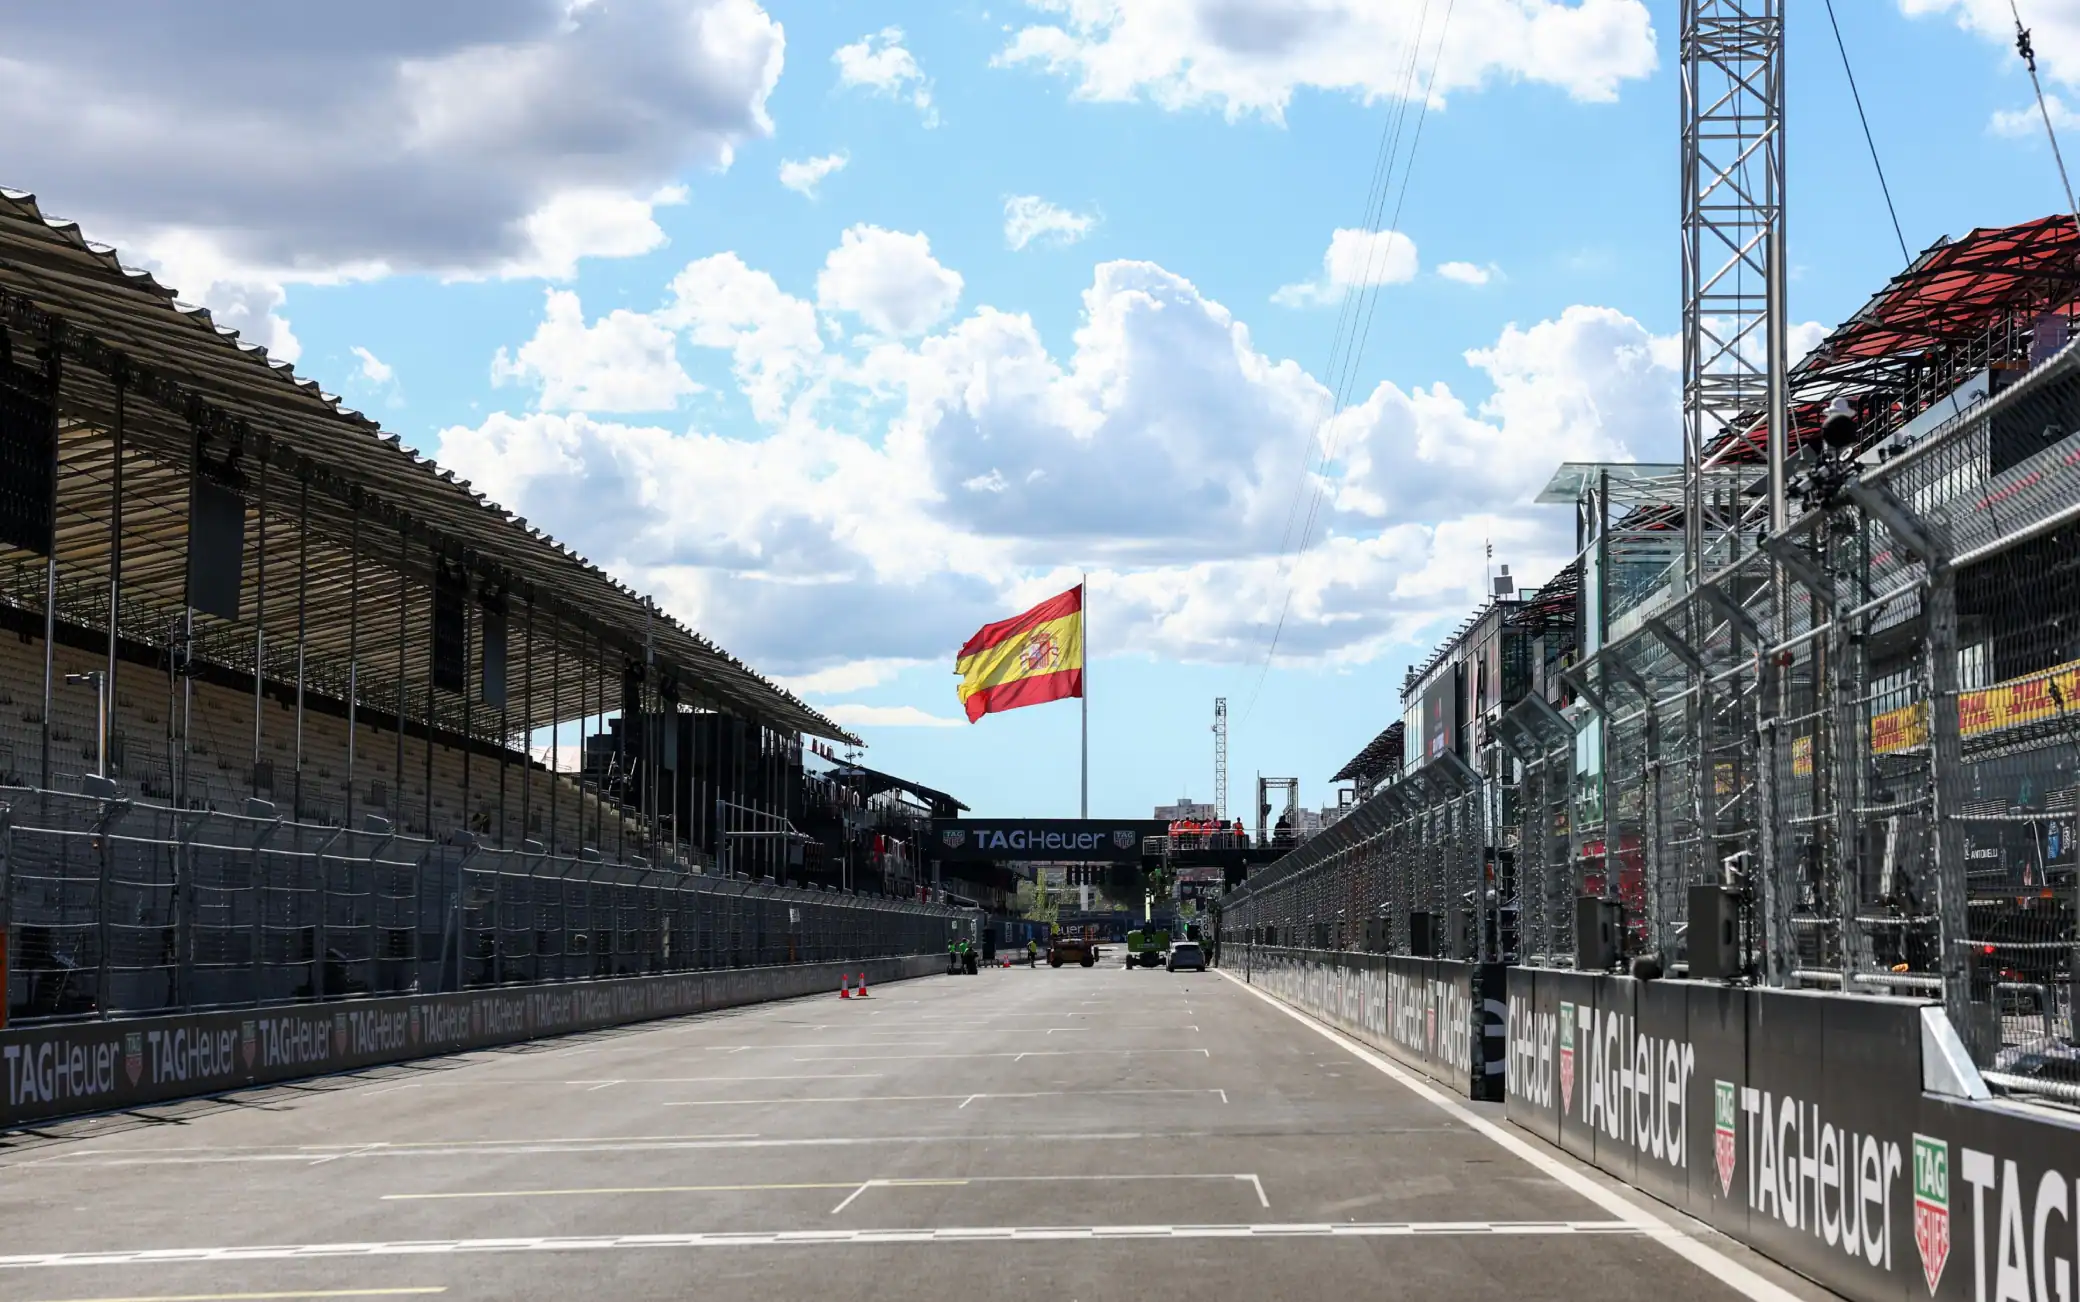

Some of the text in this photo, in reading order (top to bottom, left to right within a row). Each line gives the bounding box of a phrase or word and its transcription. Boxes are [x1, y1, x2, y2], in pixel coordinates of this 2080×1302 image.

[973, 830, 1105, 849] TAGHeuer
[259, 1016, 332, 1067] TAGHeuer
[350, 1009, 407, 1054] TAGHeuer
[421, 1003, 470, 1043] TAGHeuer
[482, 997, 525, 1035] TAGHeuer
[4, 1040, 120, 1106] TAGHeuer
[148, 1026, 237, 1084] TAGHeuer
[1506, 995, 1557, 1109] GHeuer
[1578, 1005, 1694, 1168] TAGHeuer
[1716, 1088, 1734, 1126] TAG
[1741, 1086, 1902, 1271] TAGHeuer
[1916, 1145, 1946, 1200] TAG
[1916, 1205, 1949, 1284] HEUER
[1961, 1147, 2080, 1302] TAG
